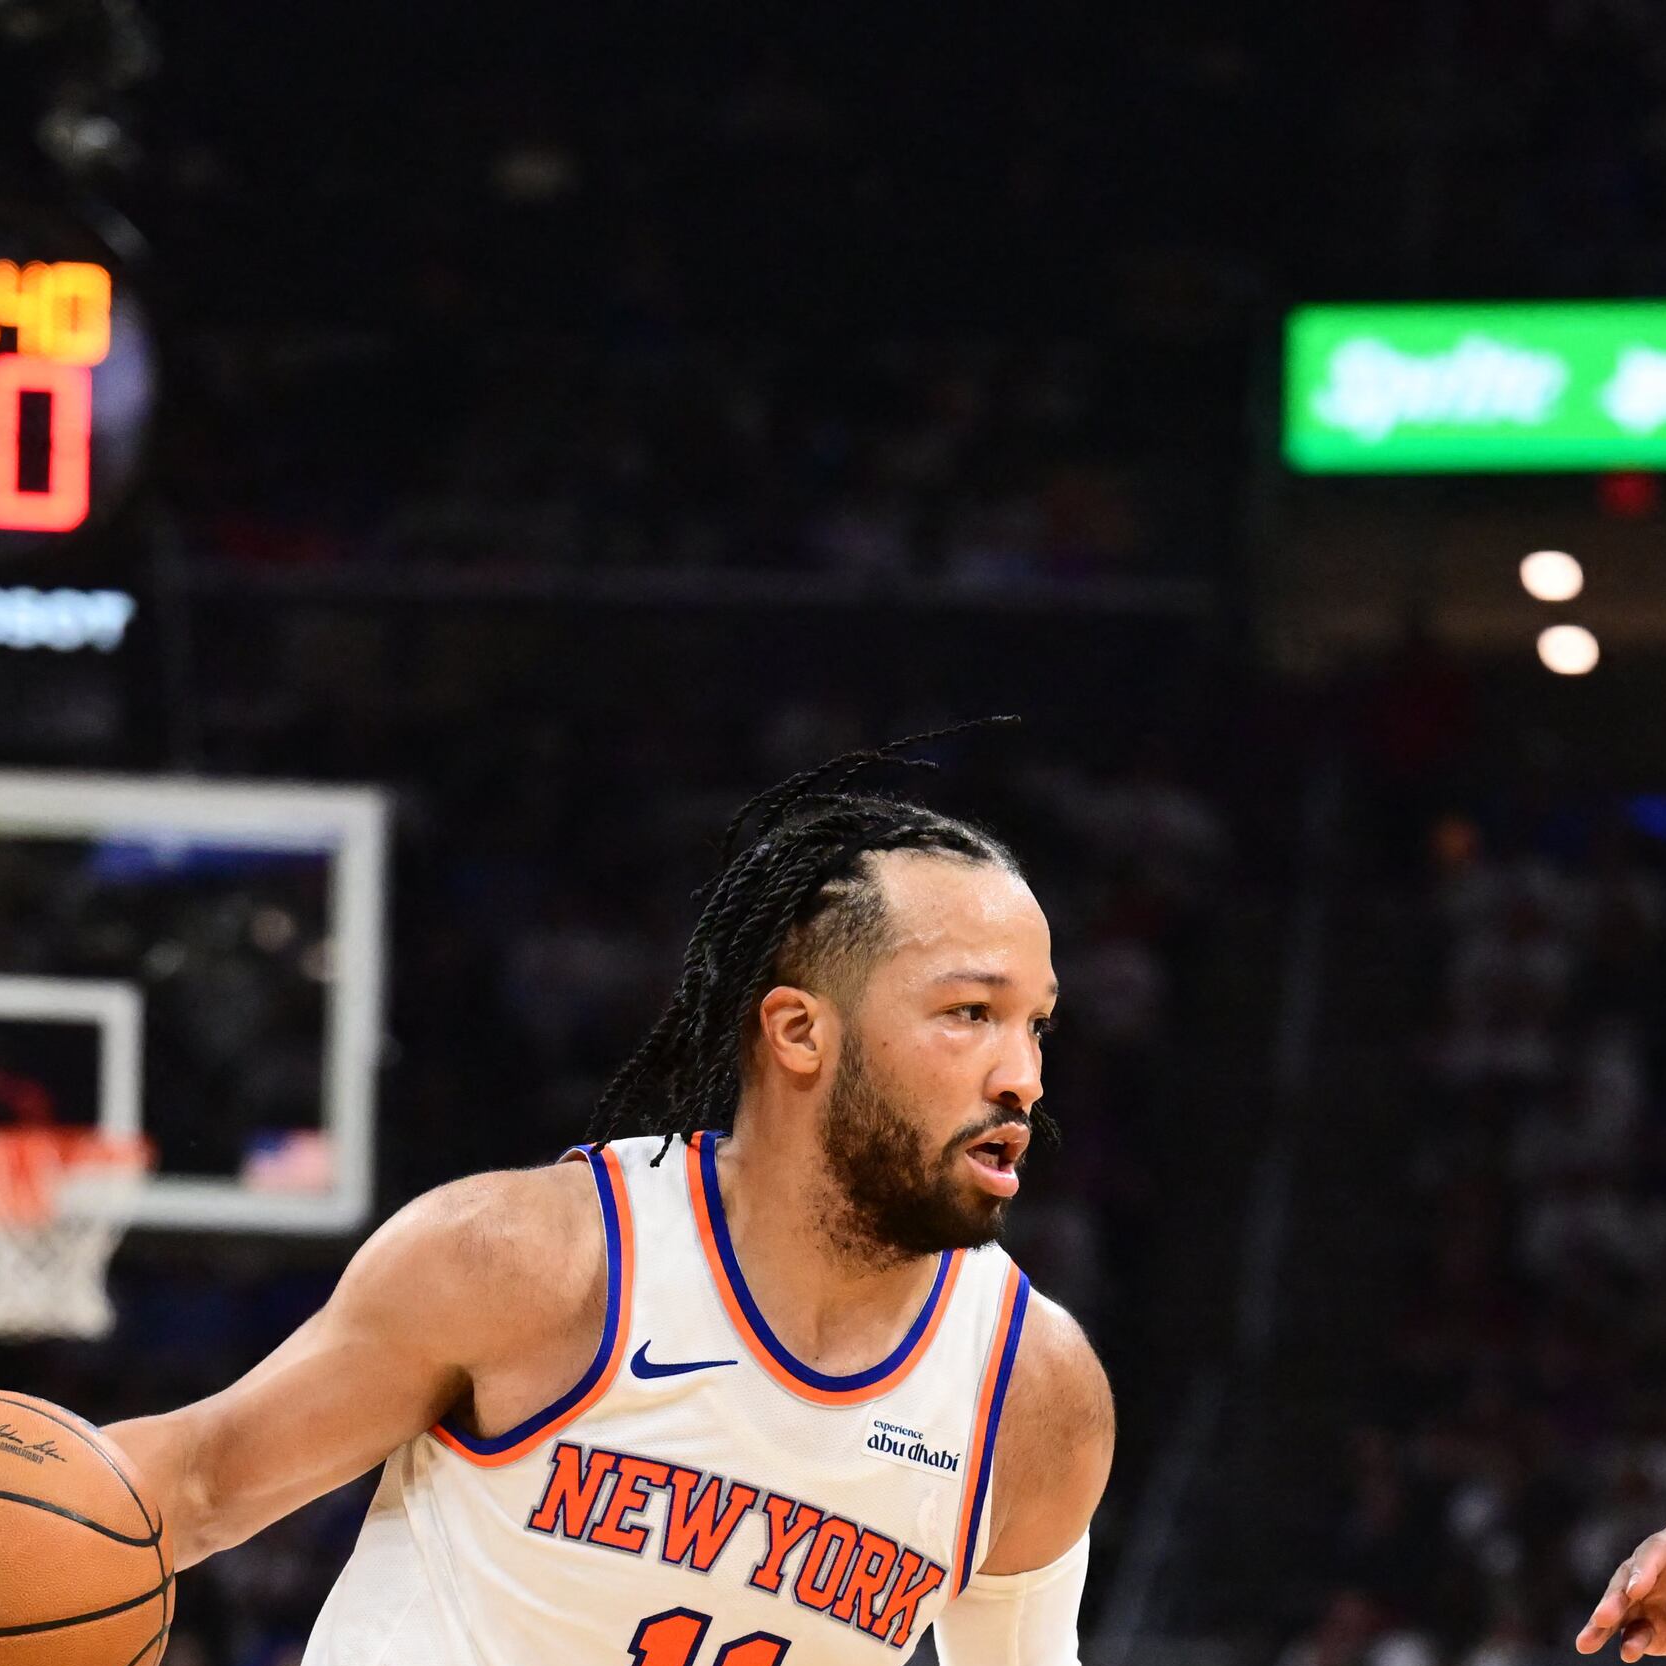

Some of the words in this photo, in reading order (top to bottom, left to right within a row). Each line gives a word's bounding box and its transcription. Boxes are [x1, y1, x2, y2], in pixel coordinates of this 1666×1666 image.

[873, 1419, 924, 1441] experience
[866, 1433, 906, 1458] abu
[527, 1440, 754, 1574] NEW
[744, 1489, 950, 1650] YORK
